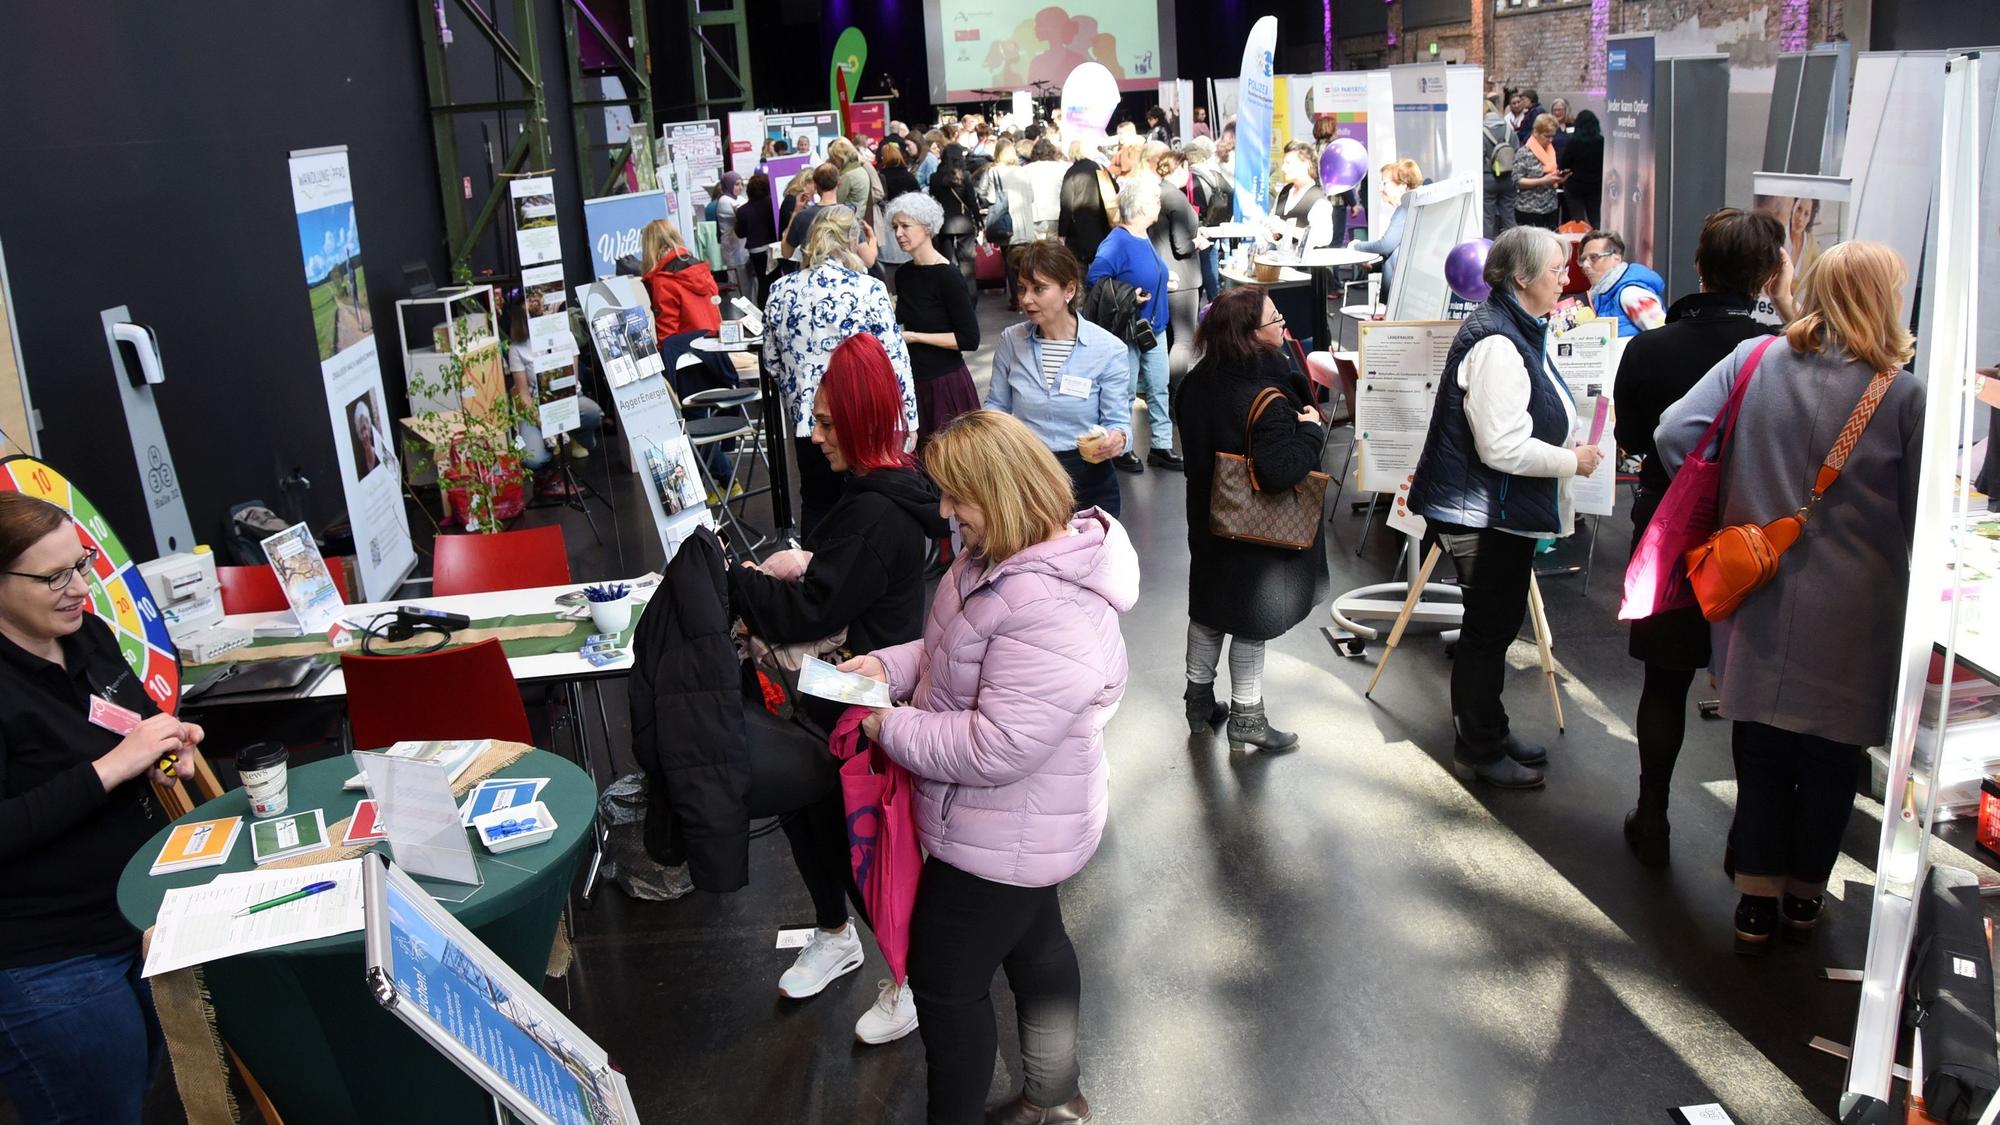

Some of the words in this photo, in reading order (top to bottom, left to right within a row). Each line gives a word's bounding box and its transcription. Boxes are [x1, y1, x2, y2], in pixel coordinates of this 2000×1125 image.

[1607, 99, 1620, 112] Jeder
[1621, 99, 1633, 112] kann
[1634, 99, 1648, 116] Opfer
[1618, 114, 1636, 127] werden
[619, 387, 667, 411] AggerEnergie
[32, 468, 52, 495] 10
[89, 515, 109, 540] 10
[116, 597, 130, 614] 20
[138, 596, 158, 622] 10
[149, 674, 172, 701] 10
